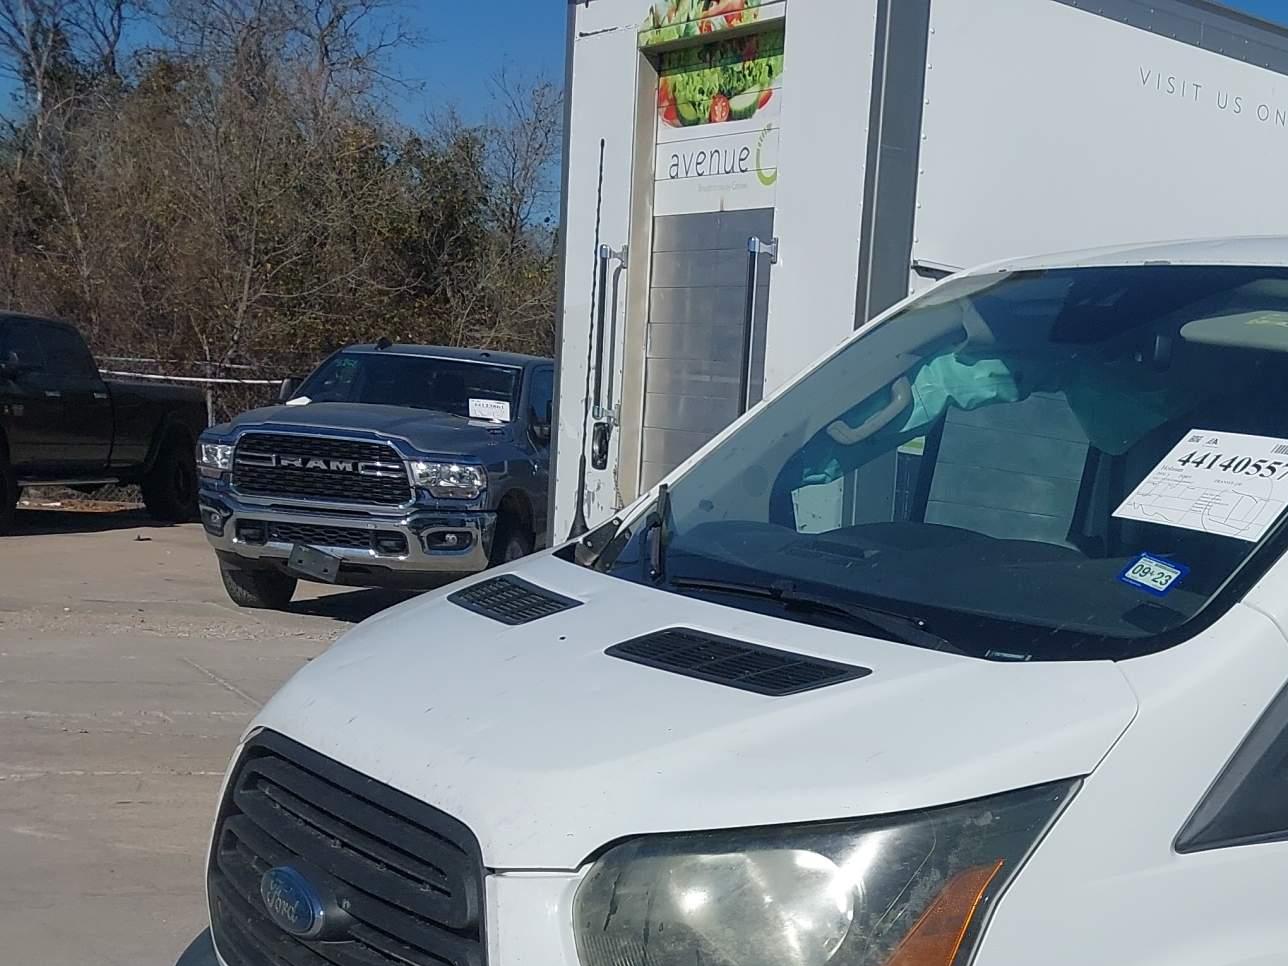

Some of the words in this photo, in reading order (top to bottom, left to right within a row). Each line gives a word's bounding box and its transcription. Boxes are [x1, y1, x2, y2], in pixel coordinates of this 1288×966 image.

[1139, 66, 1202, 101] VISIT
[1217, 91, 1243, 114] US
[669, 146, 751, 179] avenue
[280, 458, 353, 472] RAM
[1131, 564, 1152, 578] 09
[1151, 571, 1172, 586] 23
[265, 879, 300, 923] Ford
